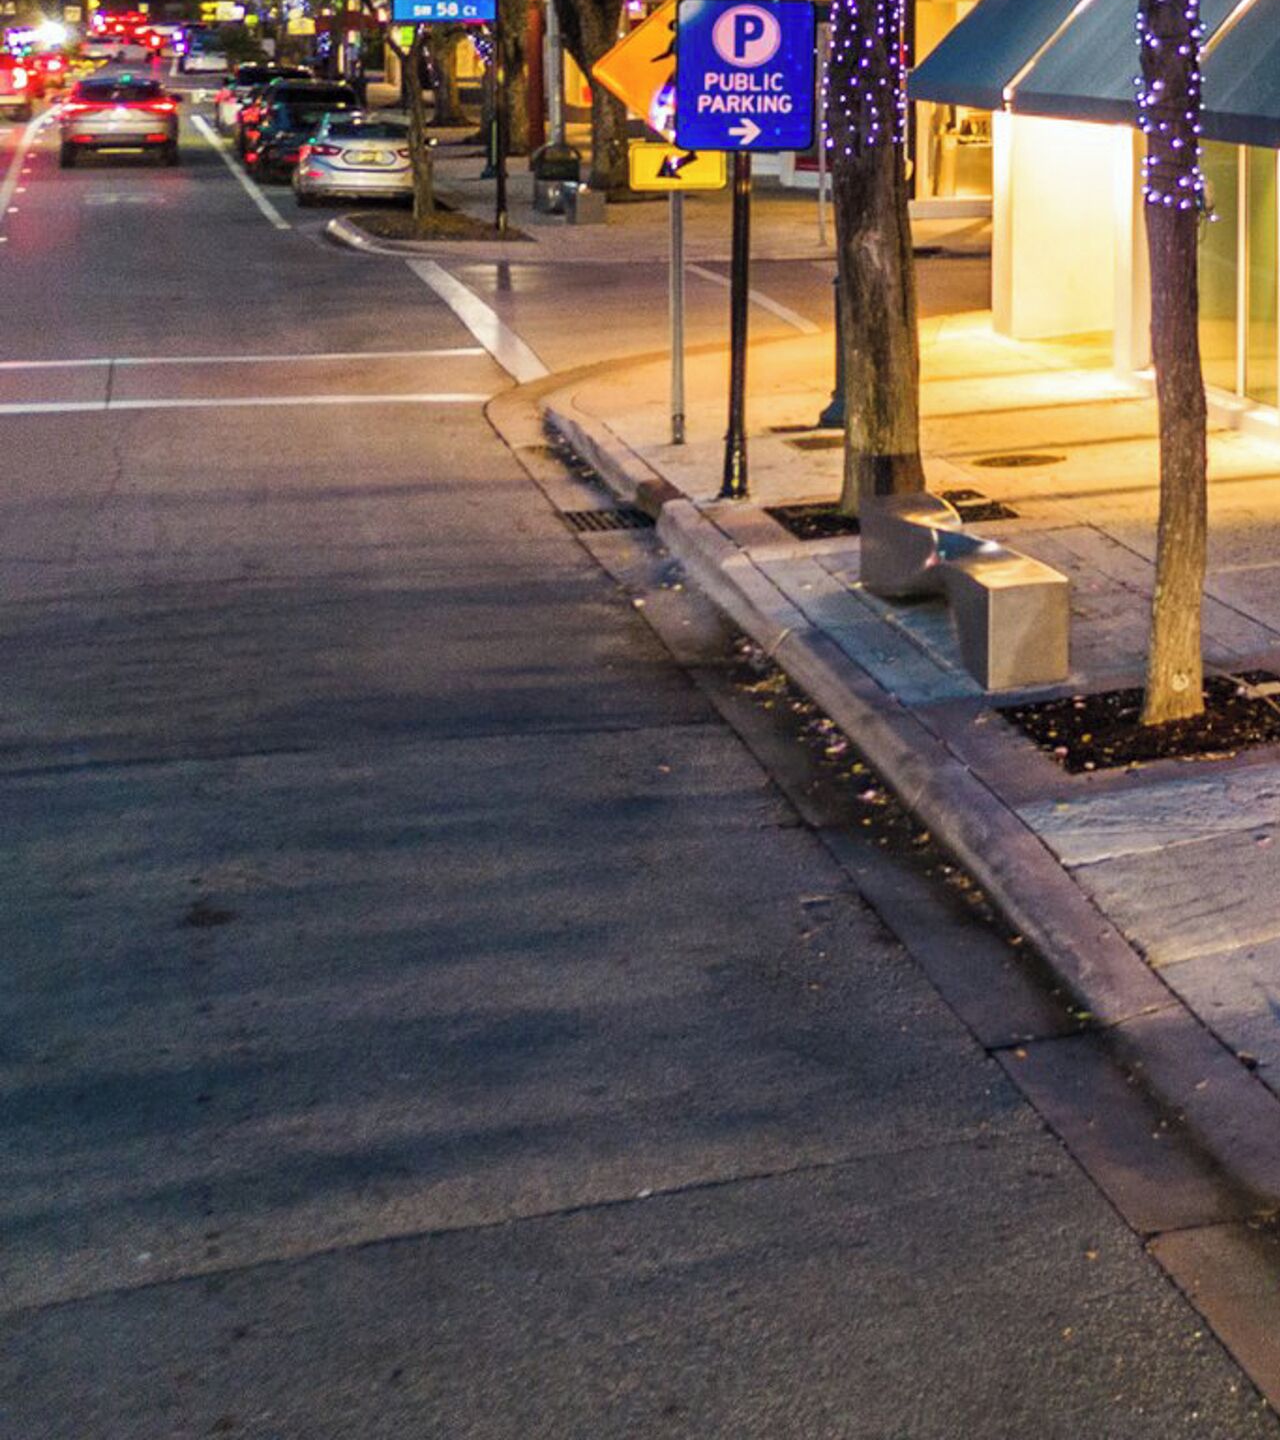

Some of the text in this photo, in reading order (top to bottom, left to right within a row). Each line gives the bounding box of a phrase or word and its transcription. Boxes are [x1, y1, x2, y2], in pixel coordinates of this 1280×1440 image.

[436, 1, 458, 16] 58
[734, 14, 765, 59] P
[704, 72, 784, 91] PUBLIC
[698, 94, 793, 114] PARKING
